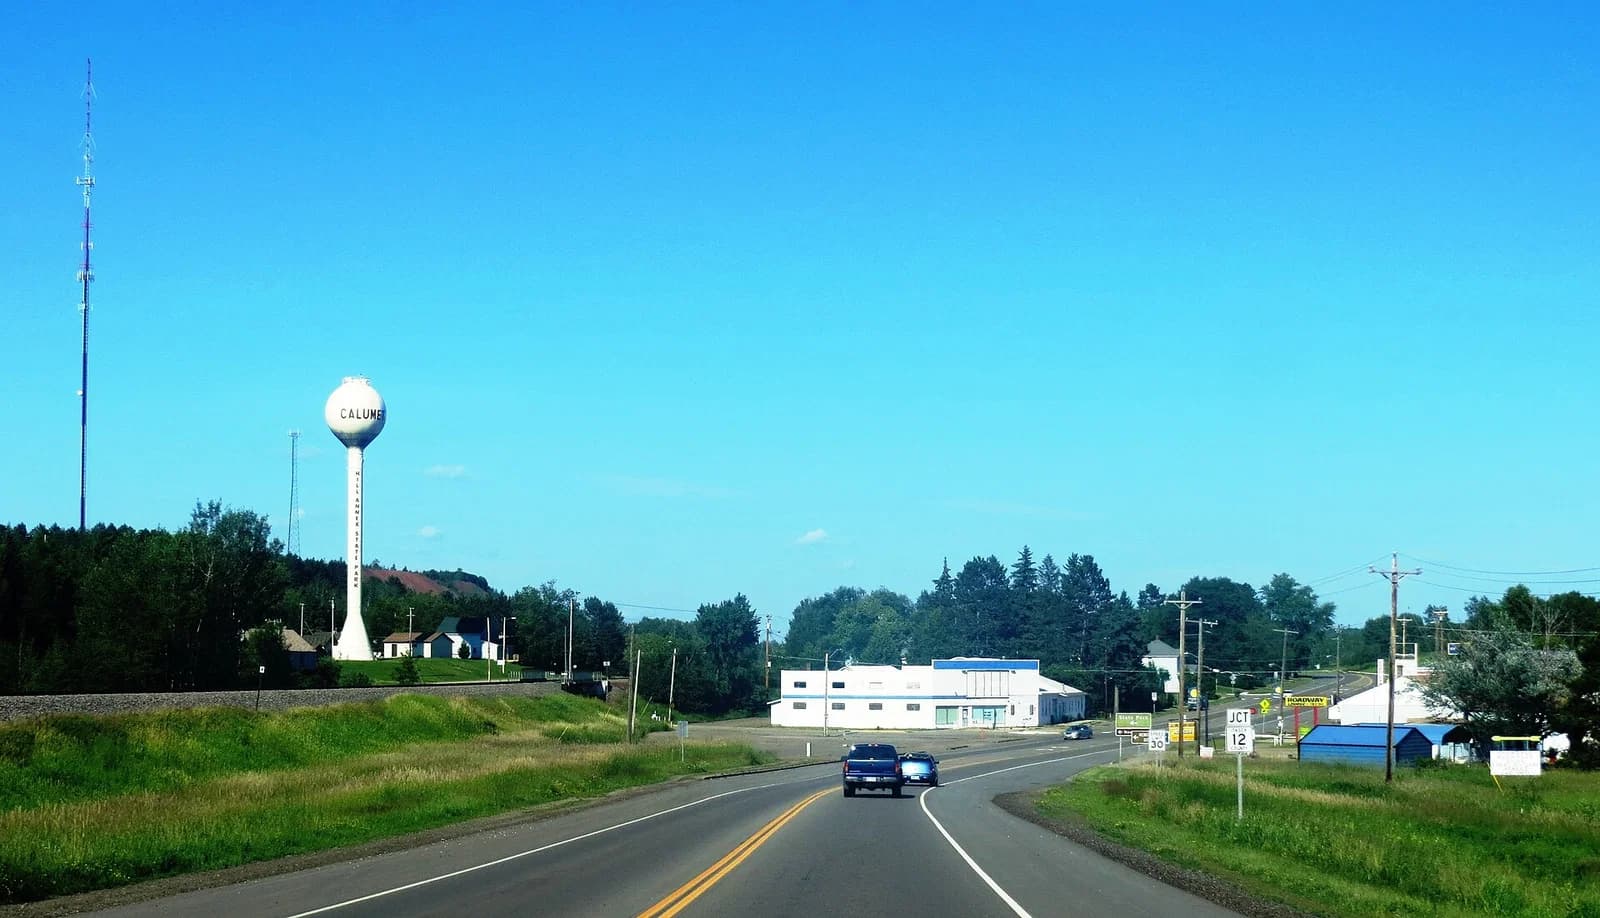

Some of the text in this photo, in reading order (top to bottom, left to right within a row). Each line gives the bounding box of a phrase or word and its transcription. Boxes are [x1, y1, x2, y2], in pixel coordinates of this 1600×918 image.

[1229, 711, 1248, 723] JCT
[1151, 740, 1164, 749] 30
[1232, 733, 1246, 745] 12
